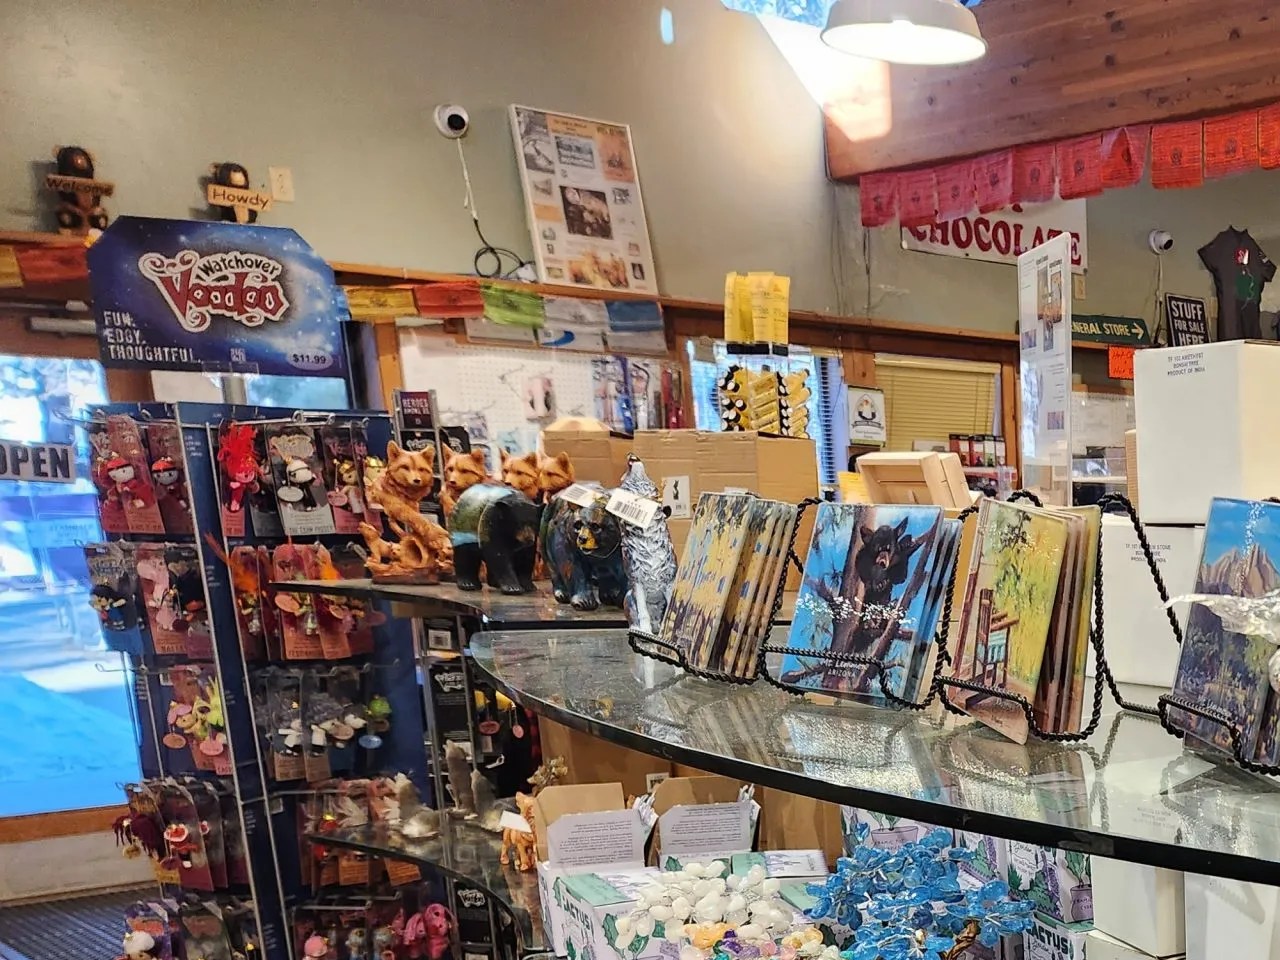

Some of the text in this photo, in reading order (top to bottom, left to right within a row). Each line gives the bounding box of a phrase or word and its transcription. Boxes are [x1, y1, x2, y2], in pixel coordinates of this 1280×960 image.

[47, 177, 114, 196] Welcome
[213, 188, 269, 209] Howdy
[199, 252, 279, 277] Watchover
[143, 252, 287, 331] Voodoo
[1171, 301, 1204, 320] STUFF
[1104, 323, 1131, 336] STORE
[1174, 319, 1206, 334] FOR SALE
[1178, 332, 1204, 346] HERE
[292, 354, 327, 365] $11.99
